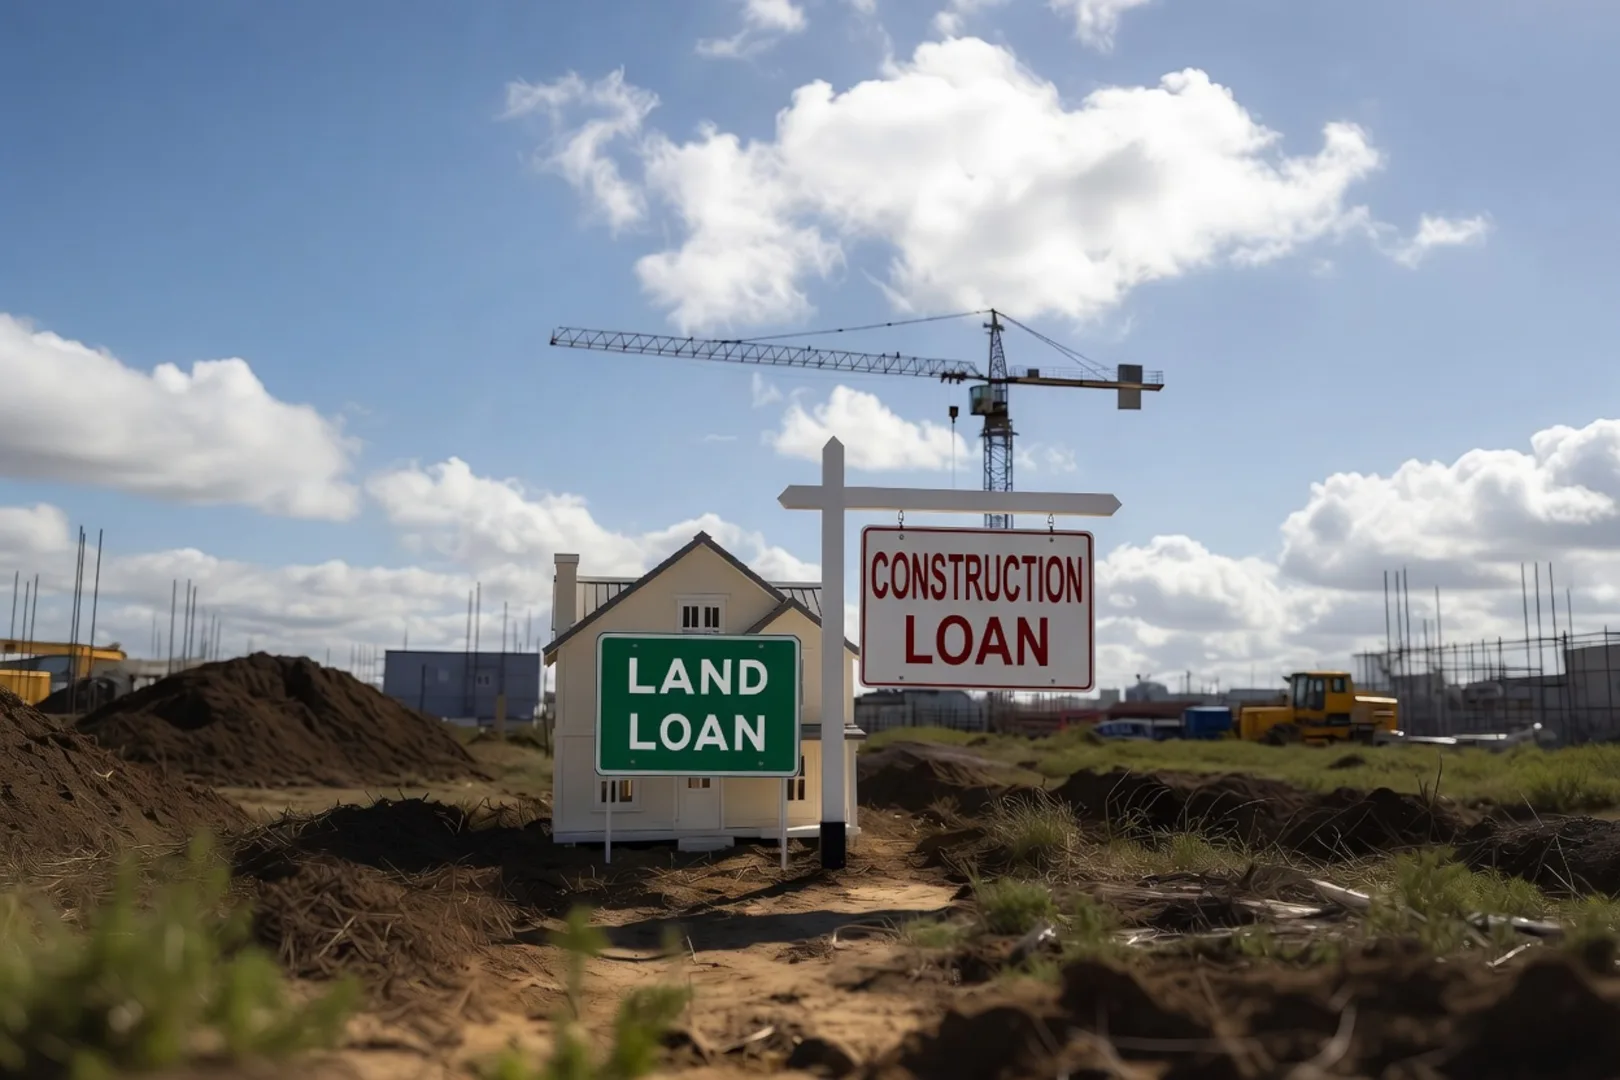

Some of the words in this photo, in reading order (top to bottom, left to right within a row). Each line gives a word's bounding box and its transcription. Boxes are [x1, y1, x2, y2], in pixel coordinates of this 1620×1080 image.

[871, 551, 1083, 604] CONSTRUCTION
[905, 615, 1049, 666] LOAN
[628, 657, 769, 695] LAND
[628, 713, 766, 752] LOAN
